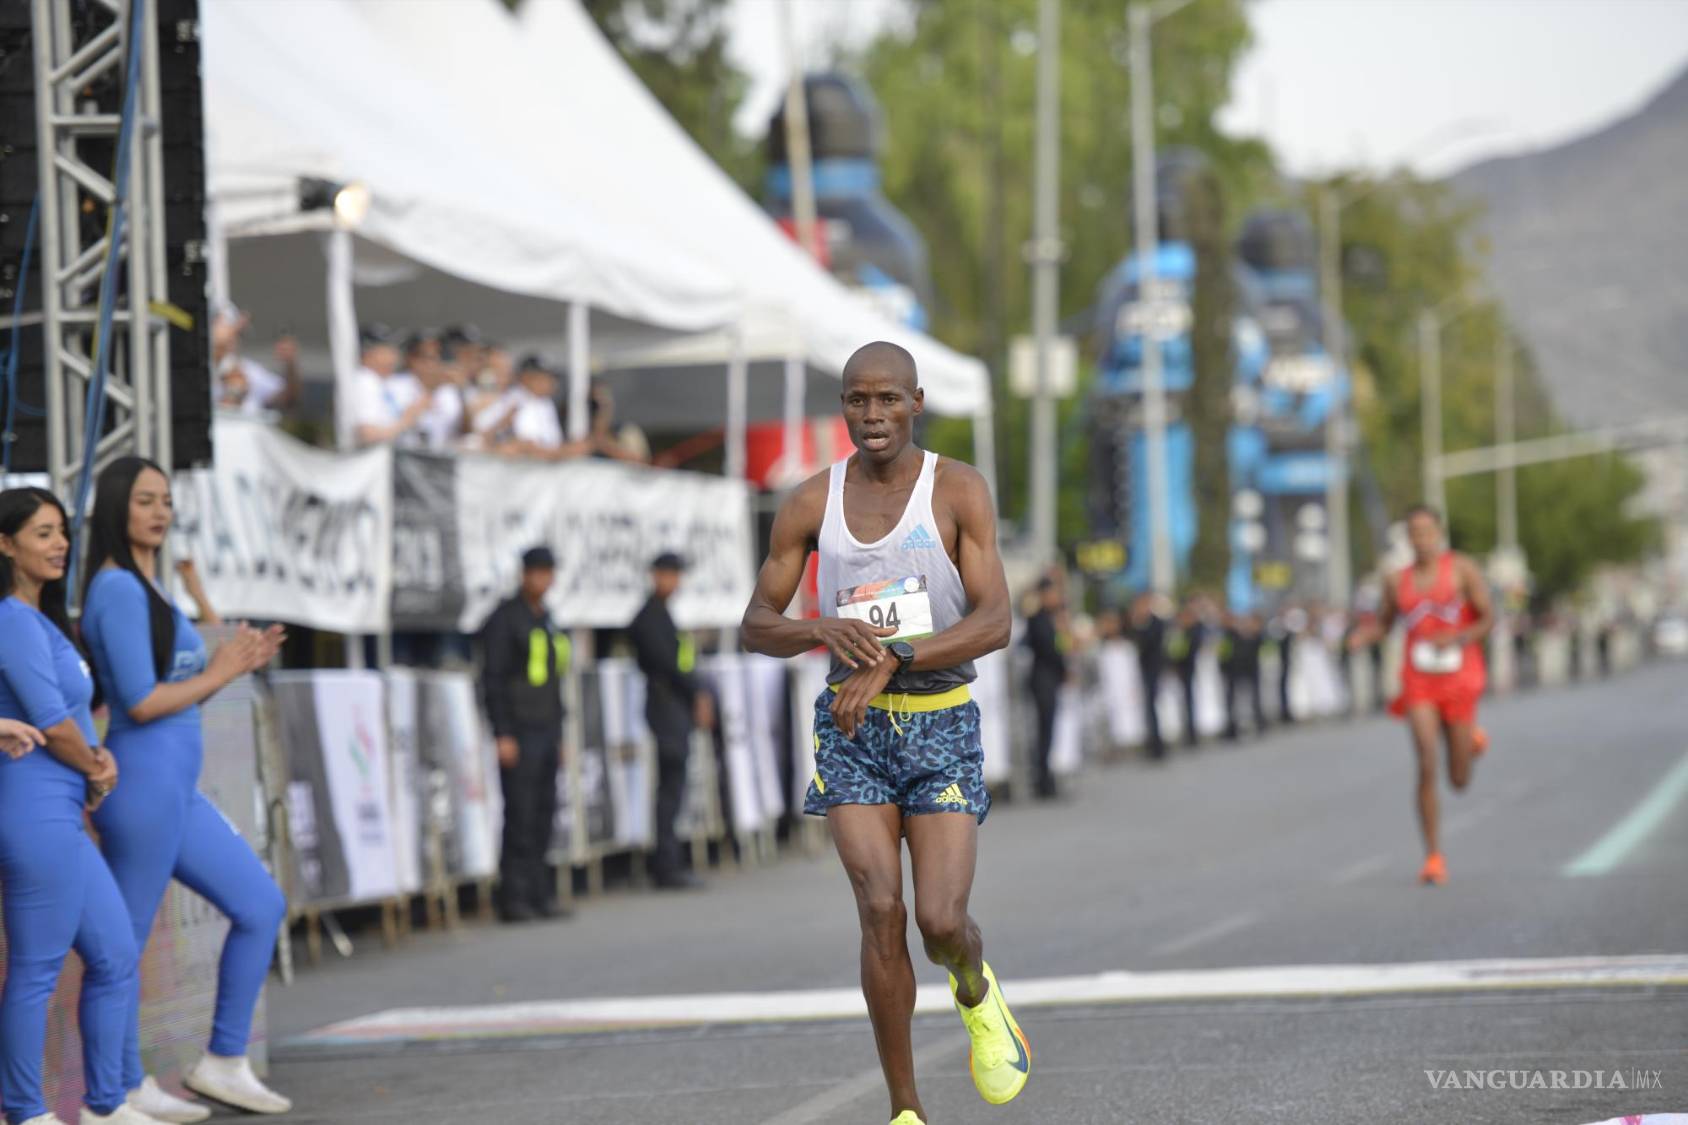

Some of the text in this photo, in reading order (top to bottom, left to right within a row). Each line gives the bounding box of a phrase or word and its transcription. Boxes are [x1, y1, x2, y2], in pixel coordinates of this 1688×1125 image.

[901, 536, 937, 551] adidas
[869, 602, 901, 631] 94
[936, 793, 968, 806] adidas
